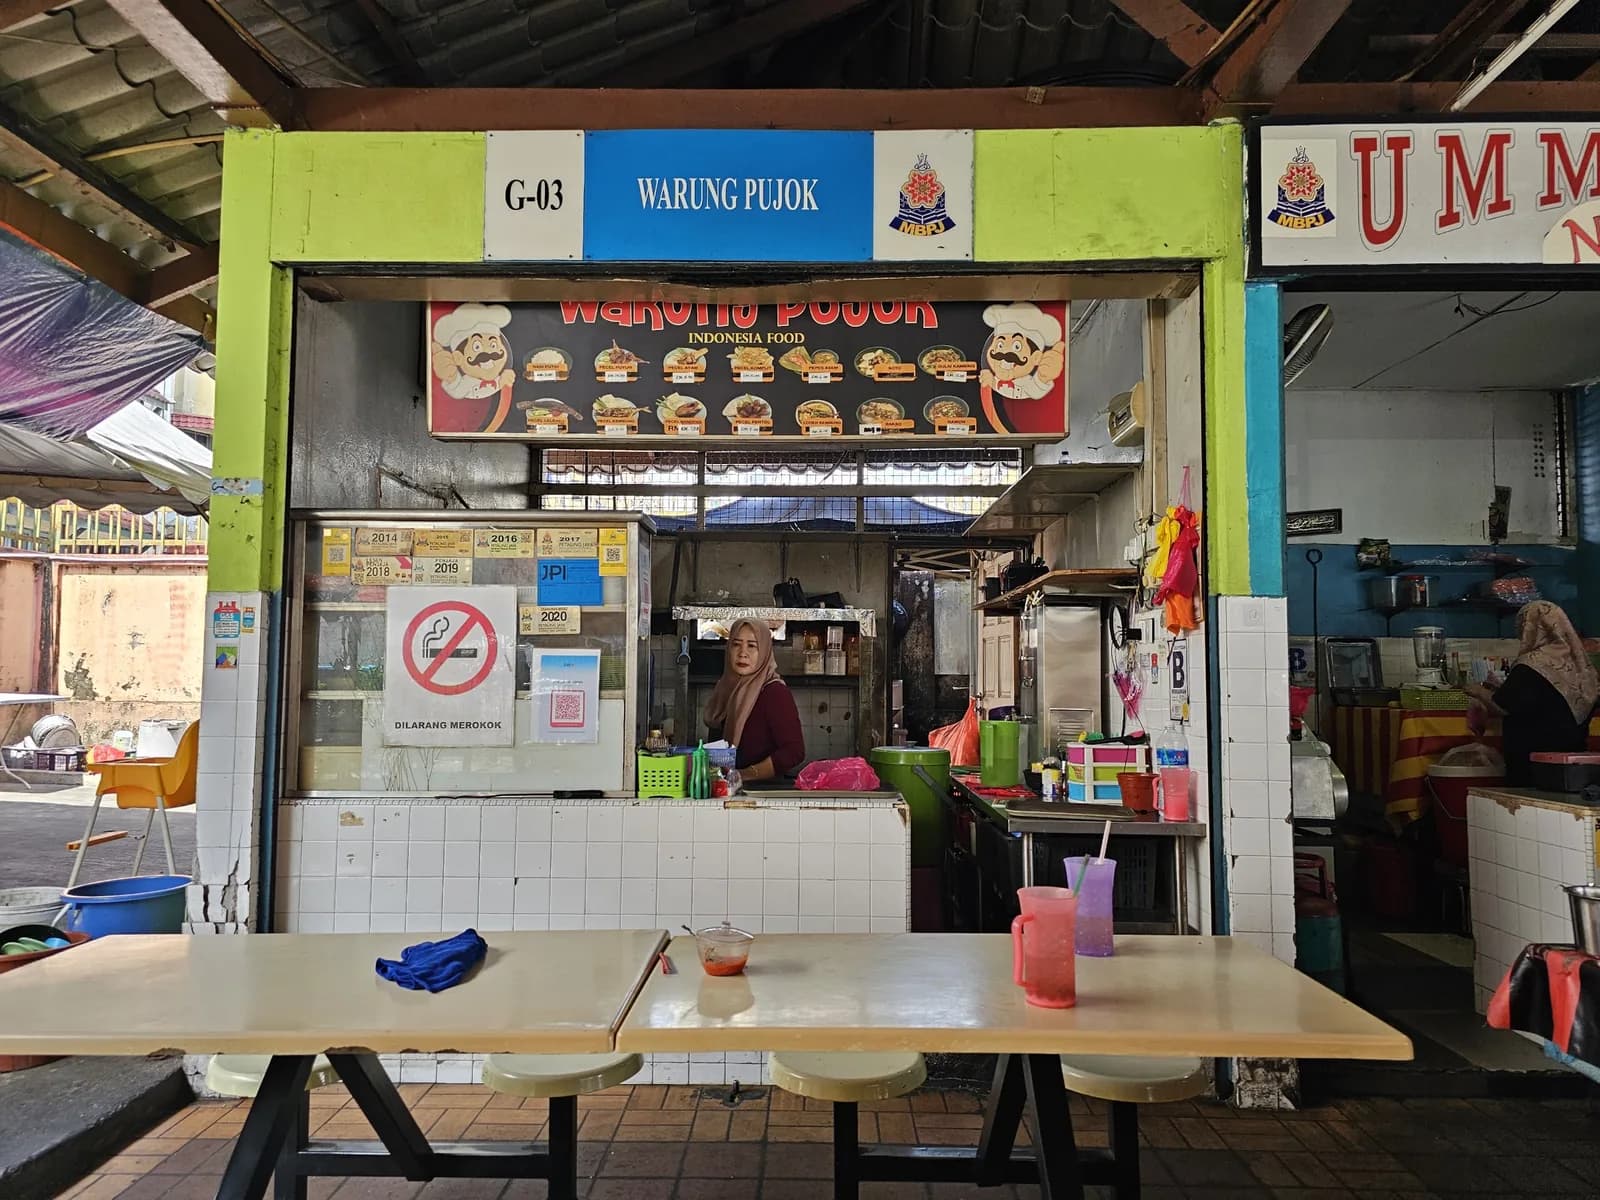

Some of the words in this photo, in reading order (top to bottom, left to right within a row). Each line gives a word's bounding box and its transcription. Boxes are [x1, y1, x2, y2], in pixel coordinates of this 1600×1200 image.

[504, 178, 565, 211] G-03
[637, 177, 738, 210] WARUNG
[743, 178, 819, 211] PUJOK
[1276, 213, 1326, 229] MBPJ
[900, 220, 945, 236] MBPJ
[688, 332, 763, 344] INDONESIA
[767, 332, 805, 344] FOOD
[371, 533, 397, 543] 2014
[491, 534, 517, 543] 2016
[366, 567, 390, 577] 2018
[434, 563, 459, 573] 2019
[541, 611, 568, 622] 2020
[1172, 651, 1185, 689] B
[394, 721, 447, 729] DILARANG
[450, 721, 502, 729] MEROKOK
